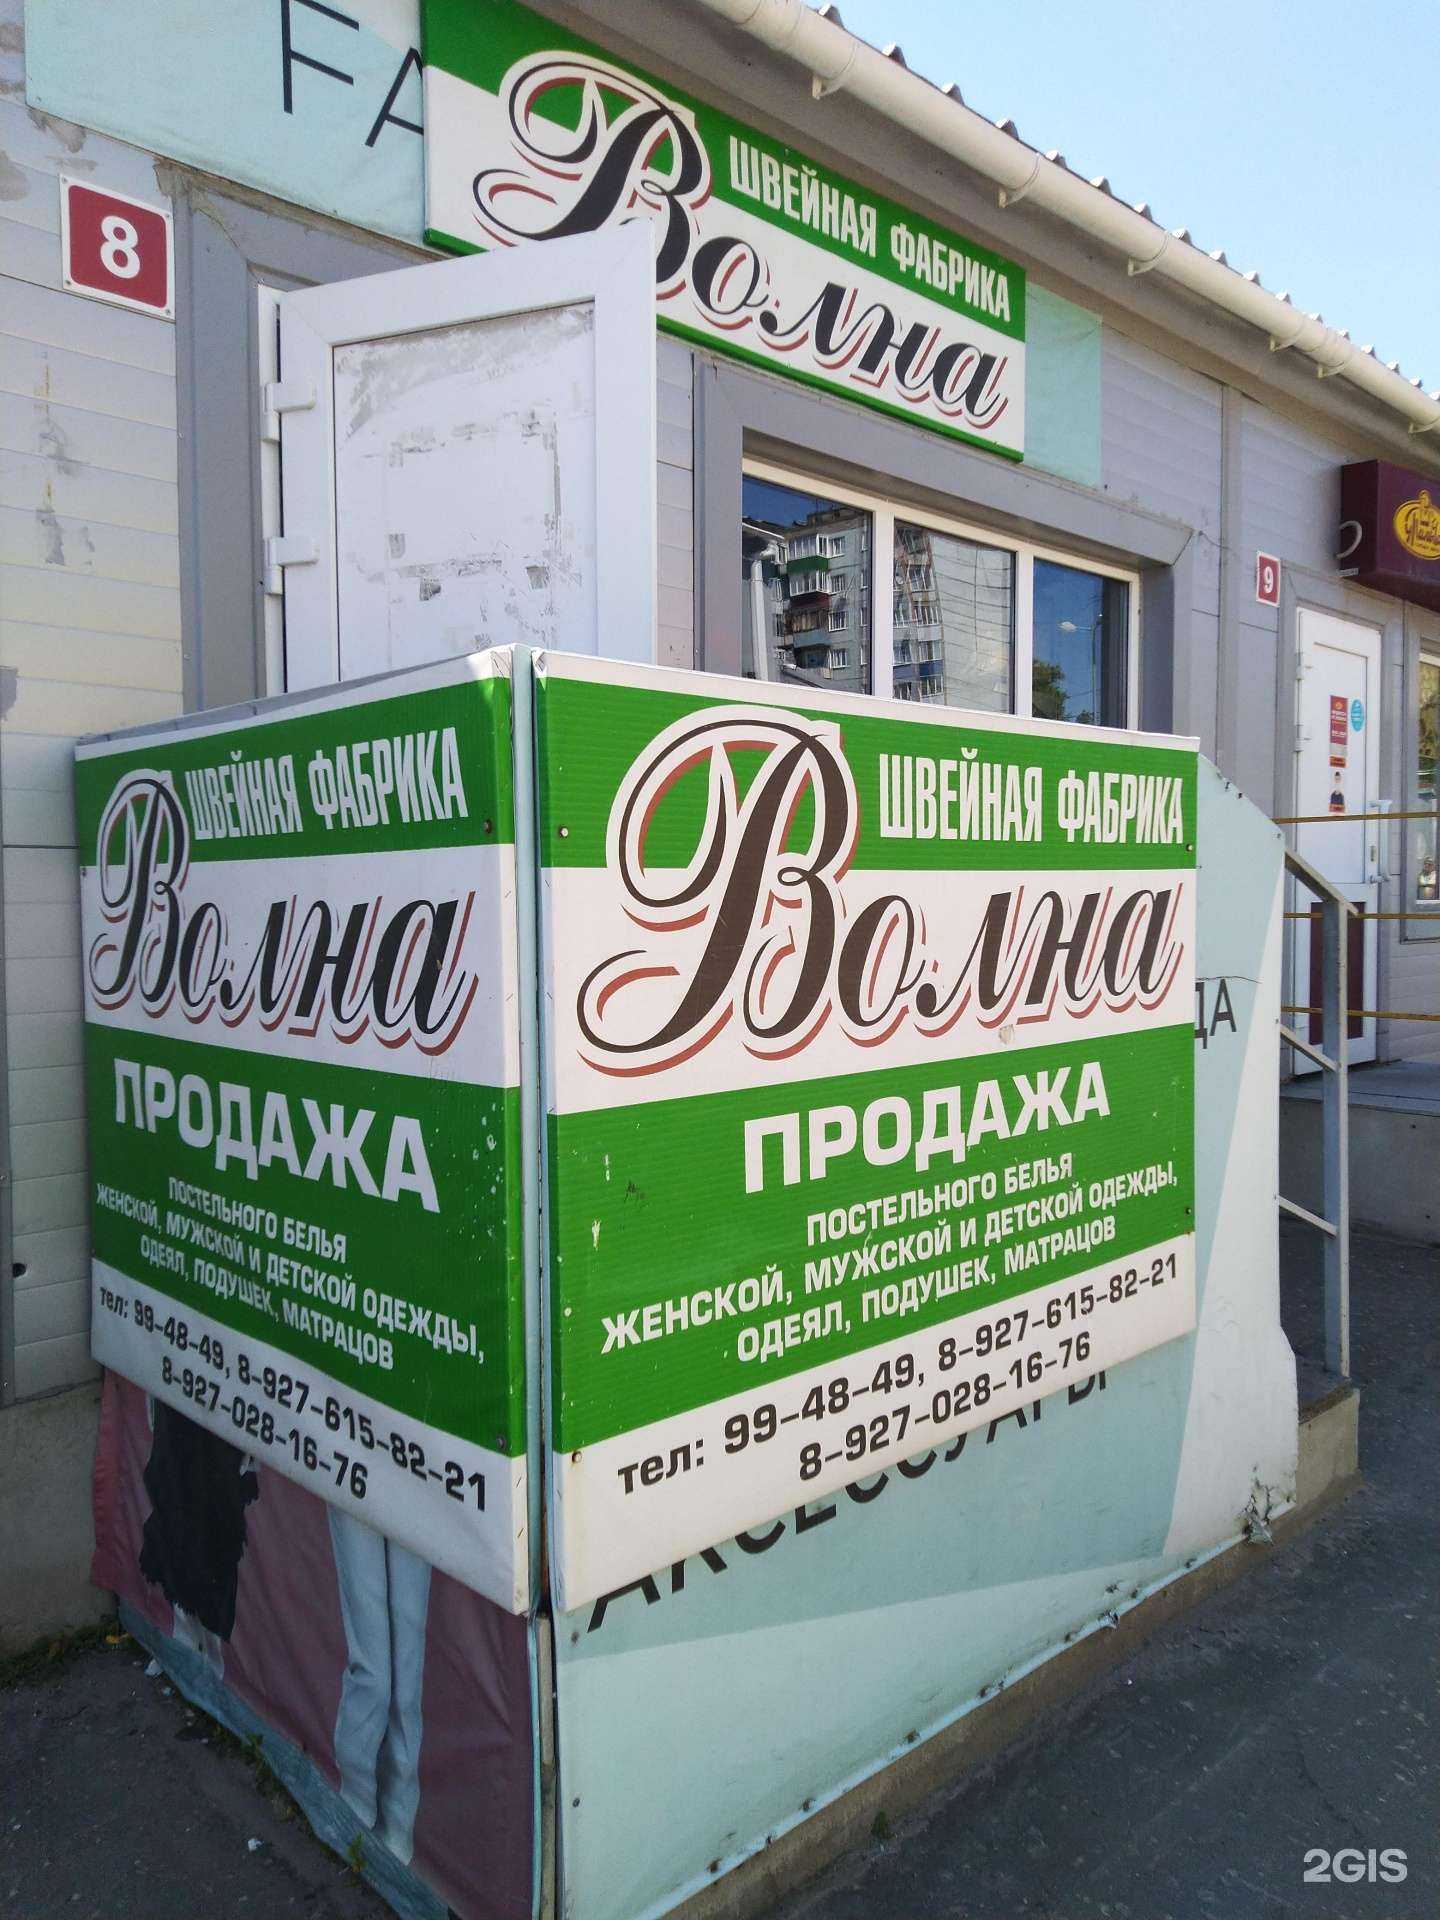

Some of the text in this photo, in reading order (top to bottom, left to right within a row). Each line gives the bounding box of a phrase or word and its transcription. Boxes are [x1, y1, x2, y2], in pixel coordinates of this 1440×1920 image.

[99, 214, 141, 279] 8
[472, 61, 1009, 429] Волна
[729, 135, 1011, 322] ШВЕЙНАЯ ФАБРИКА
[1262, 565, 1274, 594] 9
[185, 727, 468, 840] ШВЕЙНАЯ ФАБРИКА
[879, 748, 1184, 845] ШВЕЙНАЯ ФАБРИКА
[89, 778, 479, 1056] Волна
[577, 719, 1185, 1078] Волна
[113, 1057, 441, 1214] ПРОДАЖА
[743, 1061, 1111, 1194] ПРОДАЖА
[807, 1152, 1073, 1246] ПОСТЕЛЬНОГО БЕЛЬЯ
[96, 1183, 485, 1365] ЖЕНСКОЙ, МУЖСКОЙ И ДЕТСКОЙ ОДЕЖДЫ,
[168, 1176, 347, 1264] ПОСТЕЛЬНОГО БЕЛЬЯ
[601, 1160, 1179, 1354] ЖЕНСКОЙ, МУЖСКОЙ И ДЕТСКОЙ ОДЕЖДЫ,
[737, 1216, 1117, 1363] ОДЕЯЛ, ПОДУШЕК, МАТРАЦОВ
[140, 1234, 394, 1371] ОДЕЯЛ, ПОДУШЕК, МАТРАЦОВ
[617, 1252, 1179, 1495] тел: 99-48-49, 8-927-615-82-21
[99, 1286, 487, 1512] тел: 99-48-49, 8-927-615-82-21
[161, 1357, 369, 1500] 8-927-028-16-76
[799, 1331, 1092, 1483] 8-927-028-16-76
